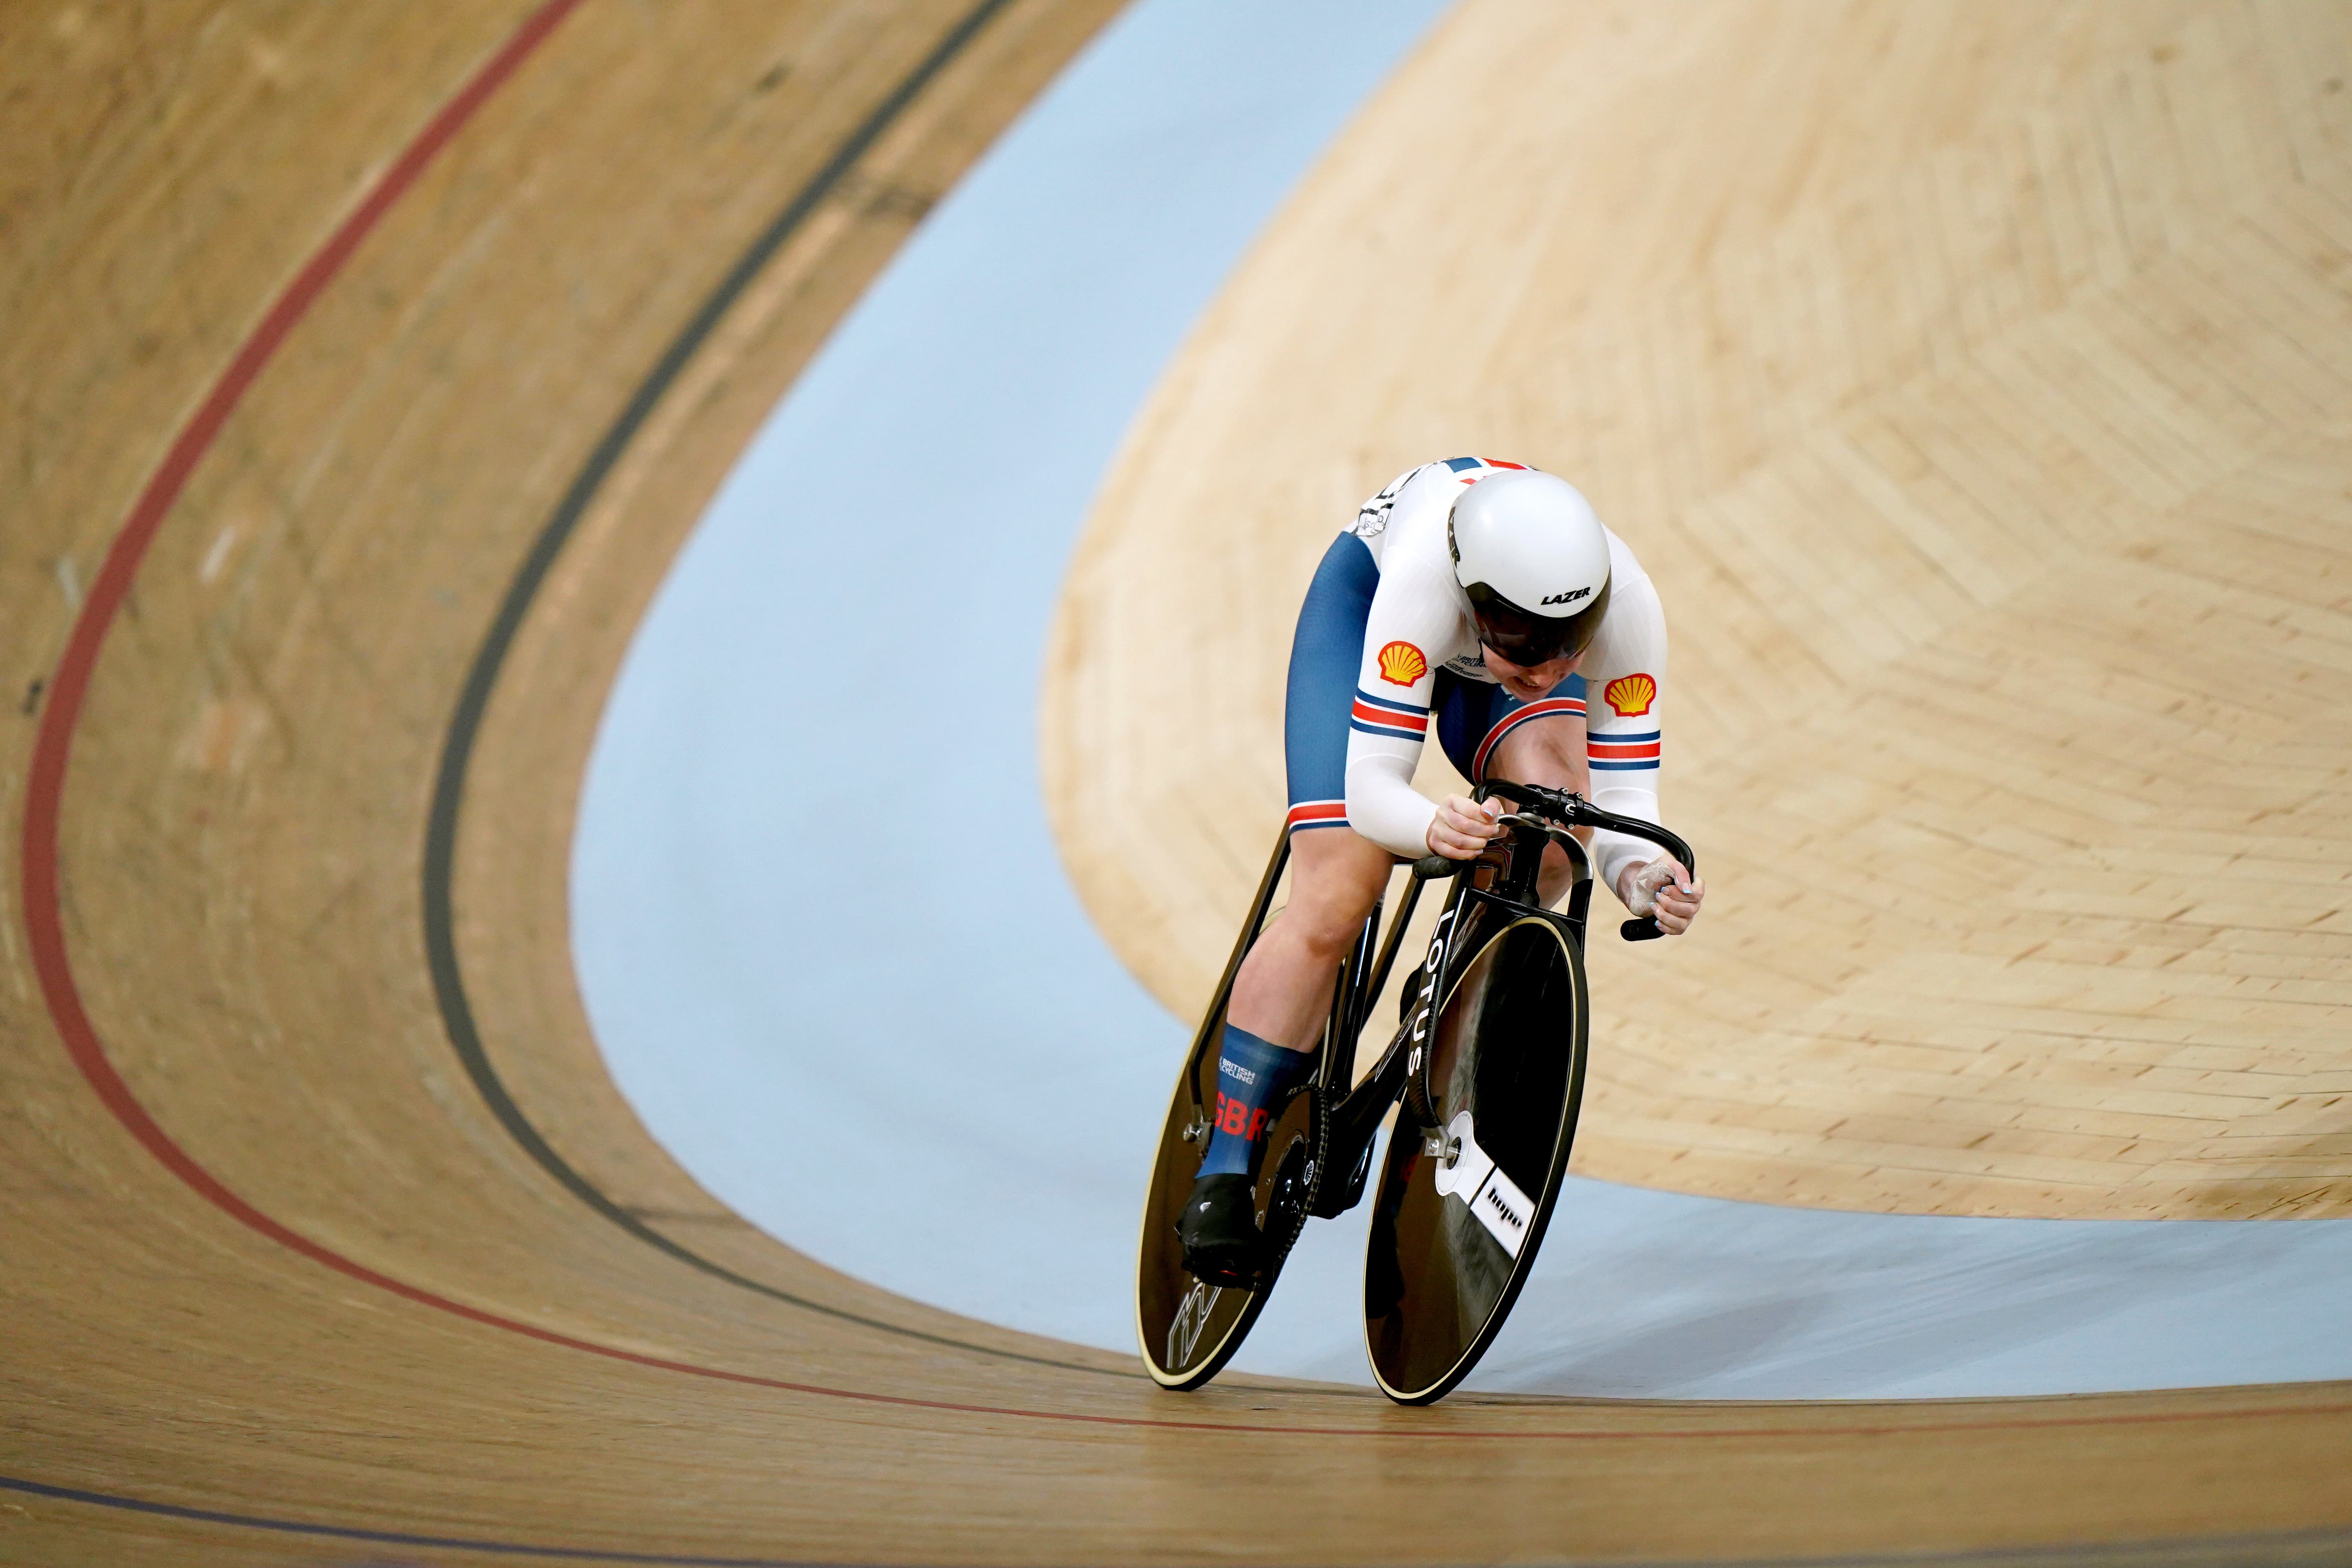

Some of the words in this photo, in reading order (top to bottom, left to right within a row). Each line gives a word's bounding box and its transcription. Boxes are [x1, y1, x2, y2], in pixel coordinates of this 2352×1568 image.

[1540, 587, 1590, 605] LAZER
[1408, 909, 1455, 1077] LOTUS
[1221, 1065, 1254, 1085] CYCLING
[1222, 1058, 1255, 1079] BRITISH
[1487, 1187, 1522, 1227] hope
